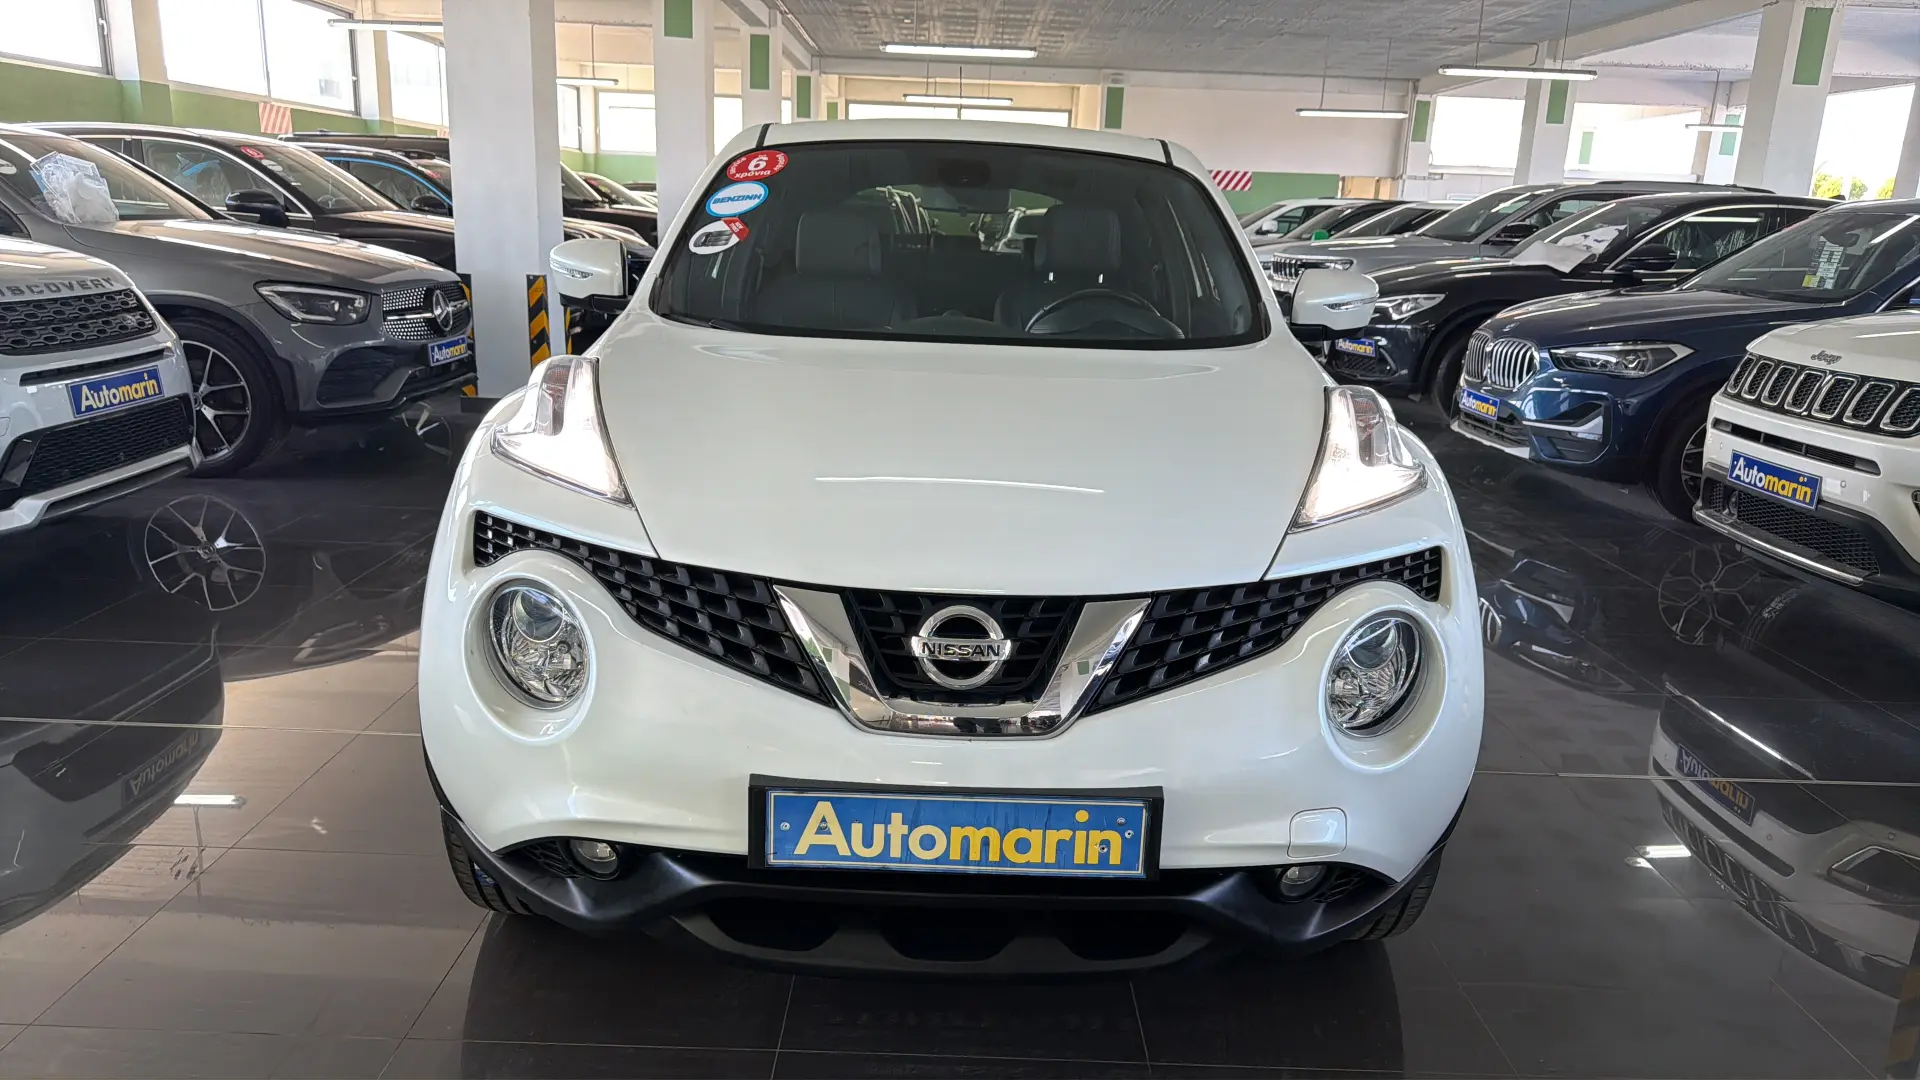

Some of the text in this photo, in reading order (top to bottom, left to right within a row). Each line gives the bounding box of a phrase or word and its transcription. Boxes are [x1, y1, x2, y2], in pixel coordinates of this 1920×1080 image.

[747, 156, 769, 171] 6
[81, 372, 159, 412] Automarin
[1461, 391, 1497, 416] Automarin
[1732, 457, 1811, 503] Automarin
[921, 641, 1000, 657] NISSAN
[794, 800, 1121, 865] Automarin
